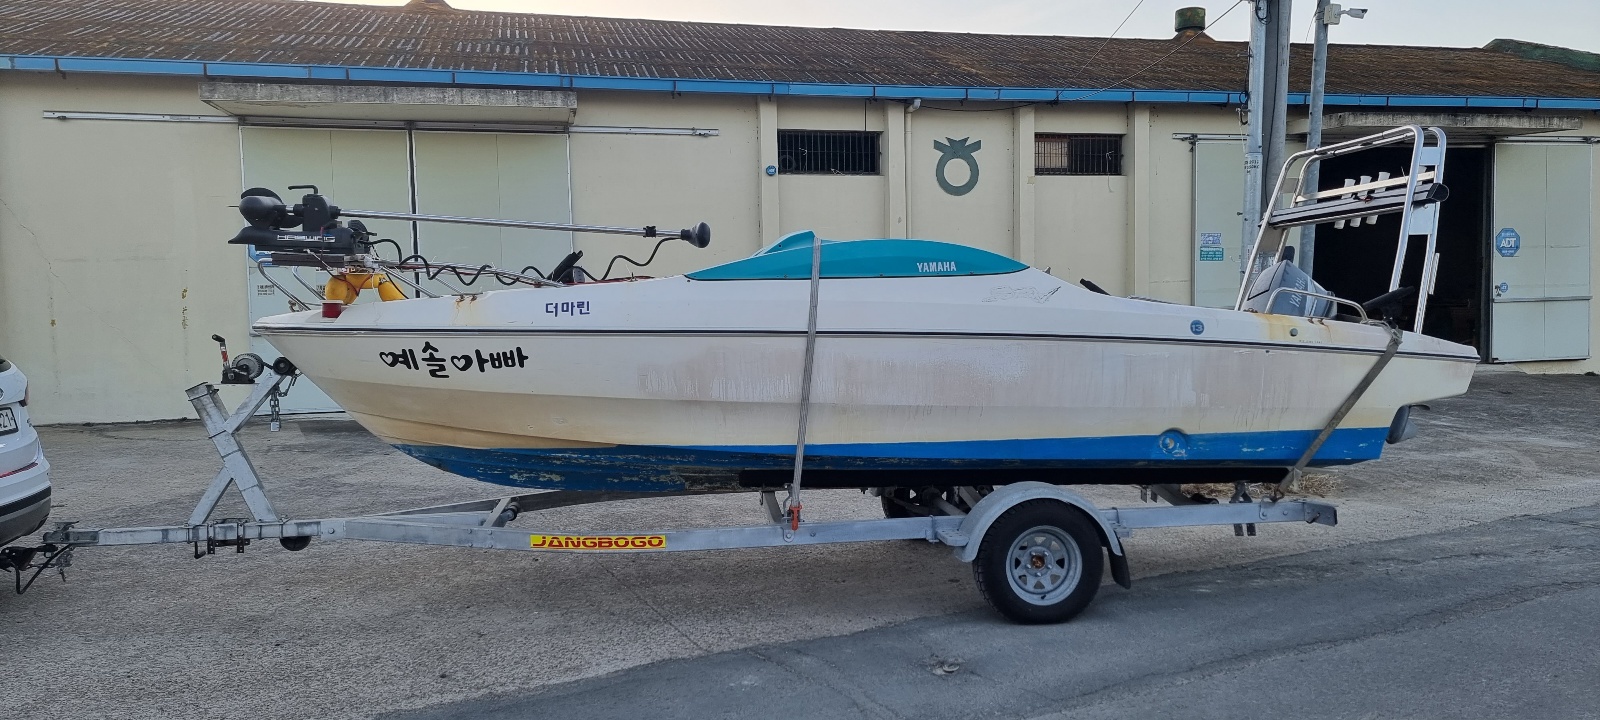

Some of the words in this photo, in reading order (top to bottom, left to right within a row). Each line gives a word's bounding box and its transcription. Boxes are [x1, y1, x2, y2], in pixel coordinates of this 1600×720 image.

[1500, 238, 1516, 247] ADT
[917, 261, 957, 273] YAMAHA
[545, 301, 590, 317] 더마린
[1191, 324, 1204, 332] 13
[532, 536, 664, 548] JANGBOGO
